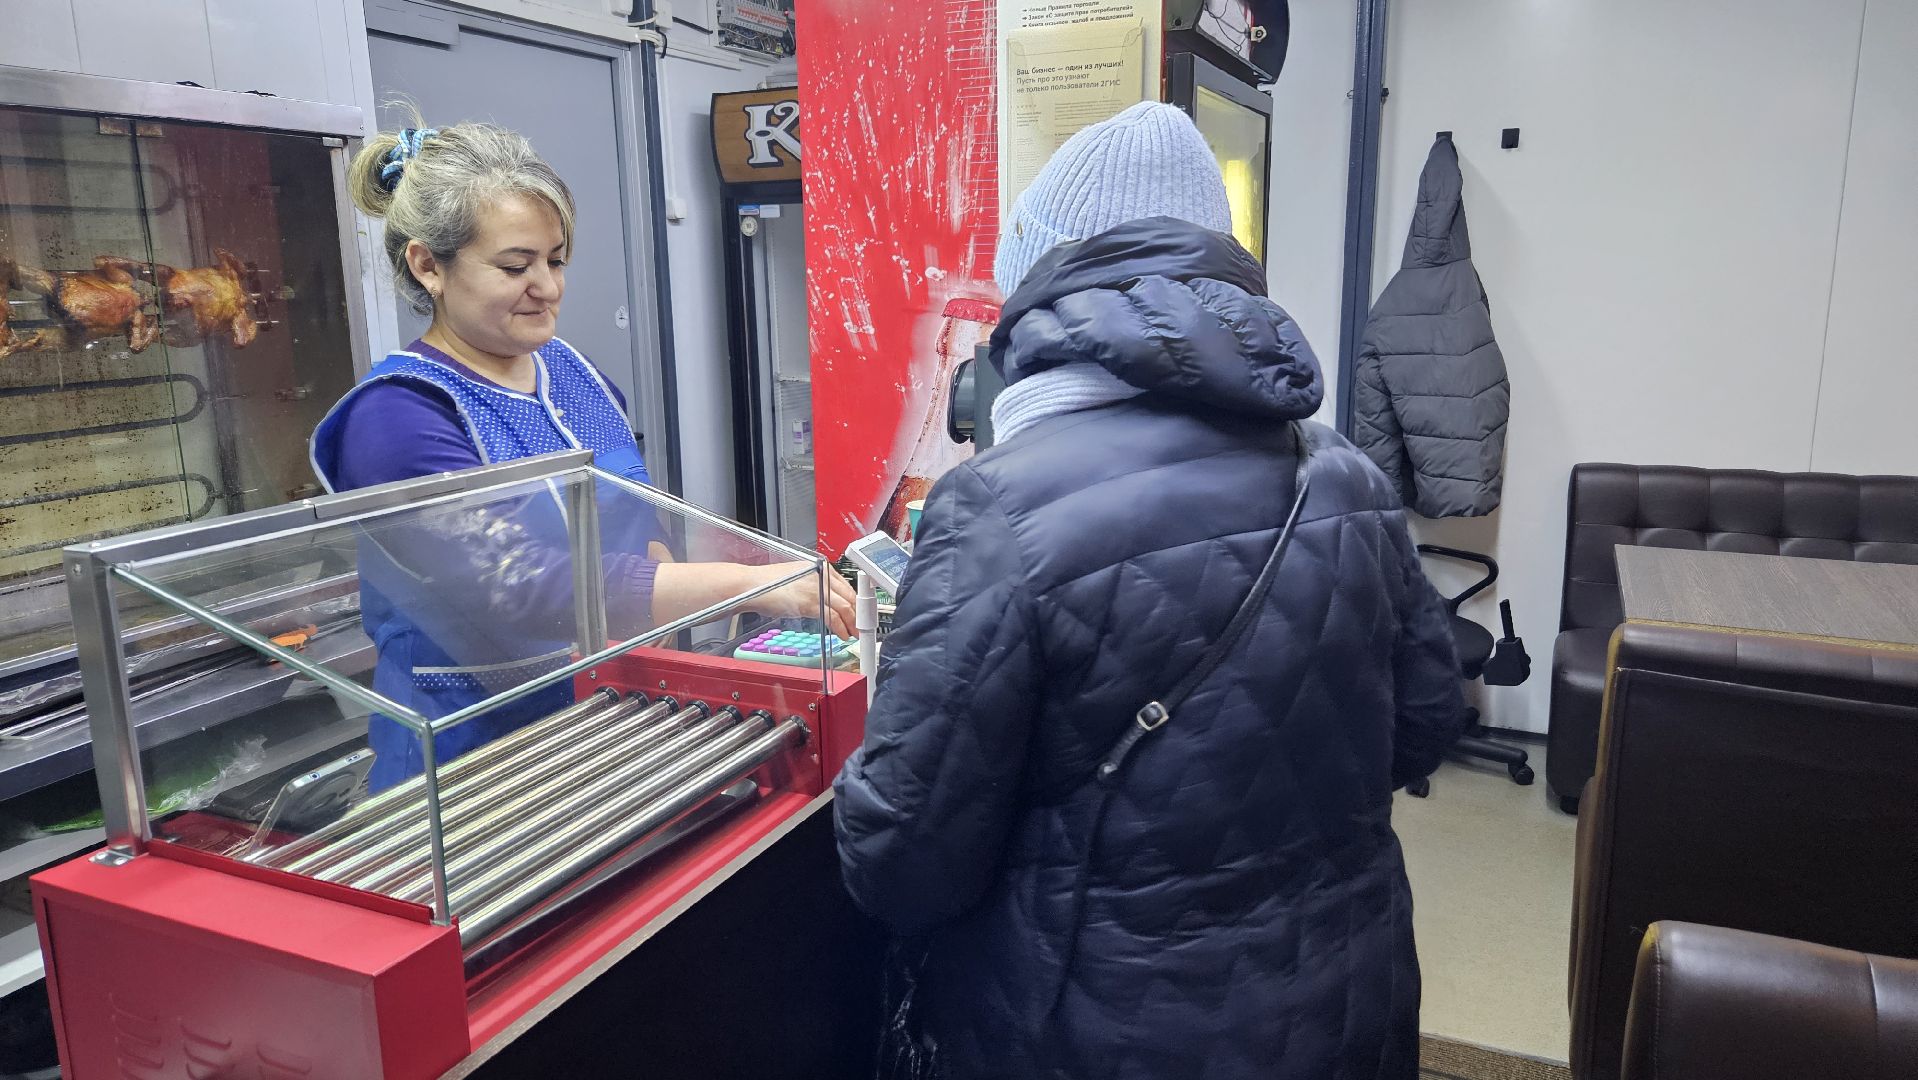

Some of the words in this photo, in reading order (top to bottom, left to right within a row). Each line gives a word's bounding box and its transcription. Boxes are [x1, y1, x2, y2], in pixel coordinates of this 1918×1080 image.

[1016, 68, 1030, 76] Ваш
[1031, 66, 1056, 74] бизнес
[1065, 64, 1083, 72] один
[1094, 60, 1124, 70] лучших!
[1037, 75, 1051, 83] про
[1065, 73, 1090, 82] узнают
[1050, 82, 1099, 91] пользователи
[1100, 79, 1121, 87] 2ГИС
